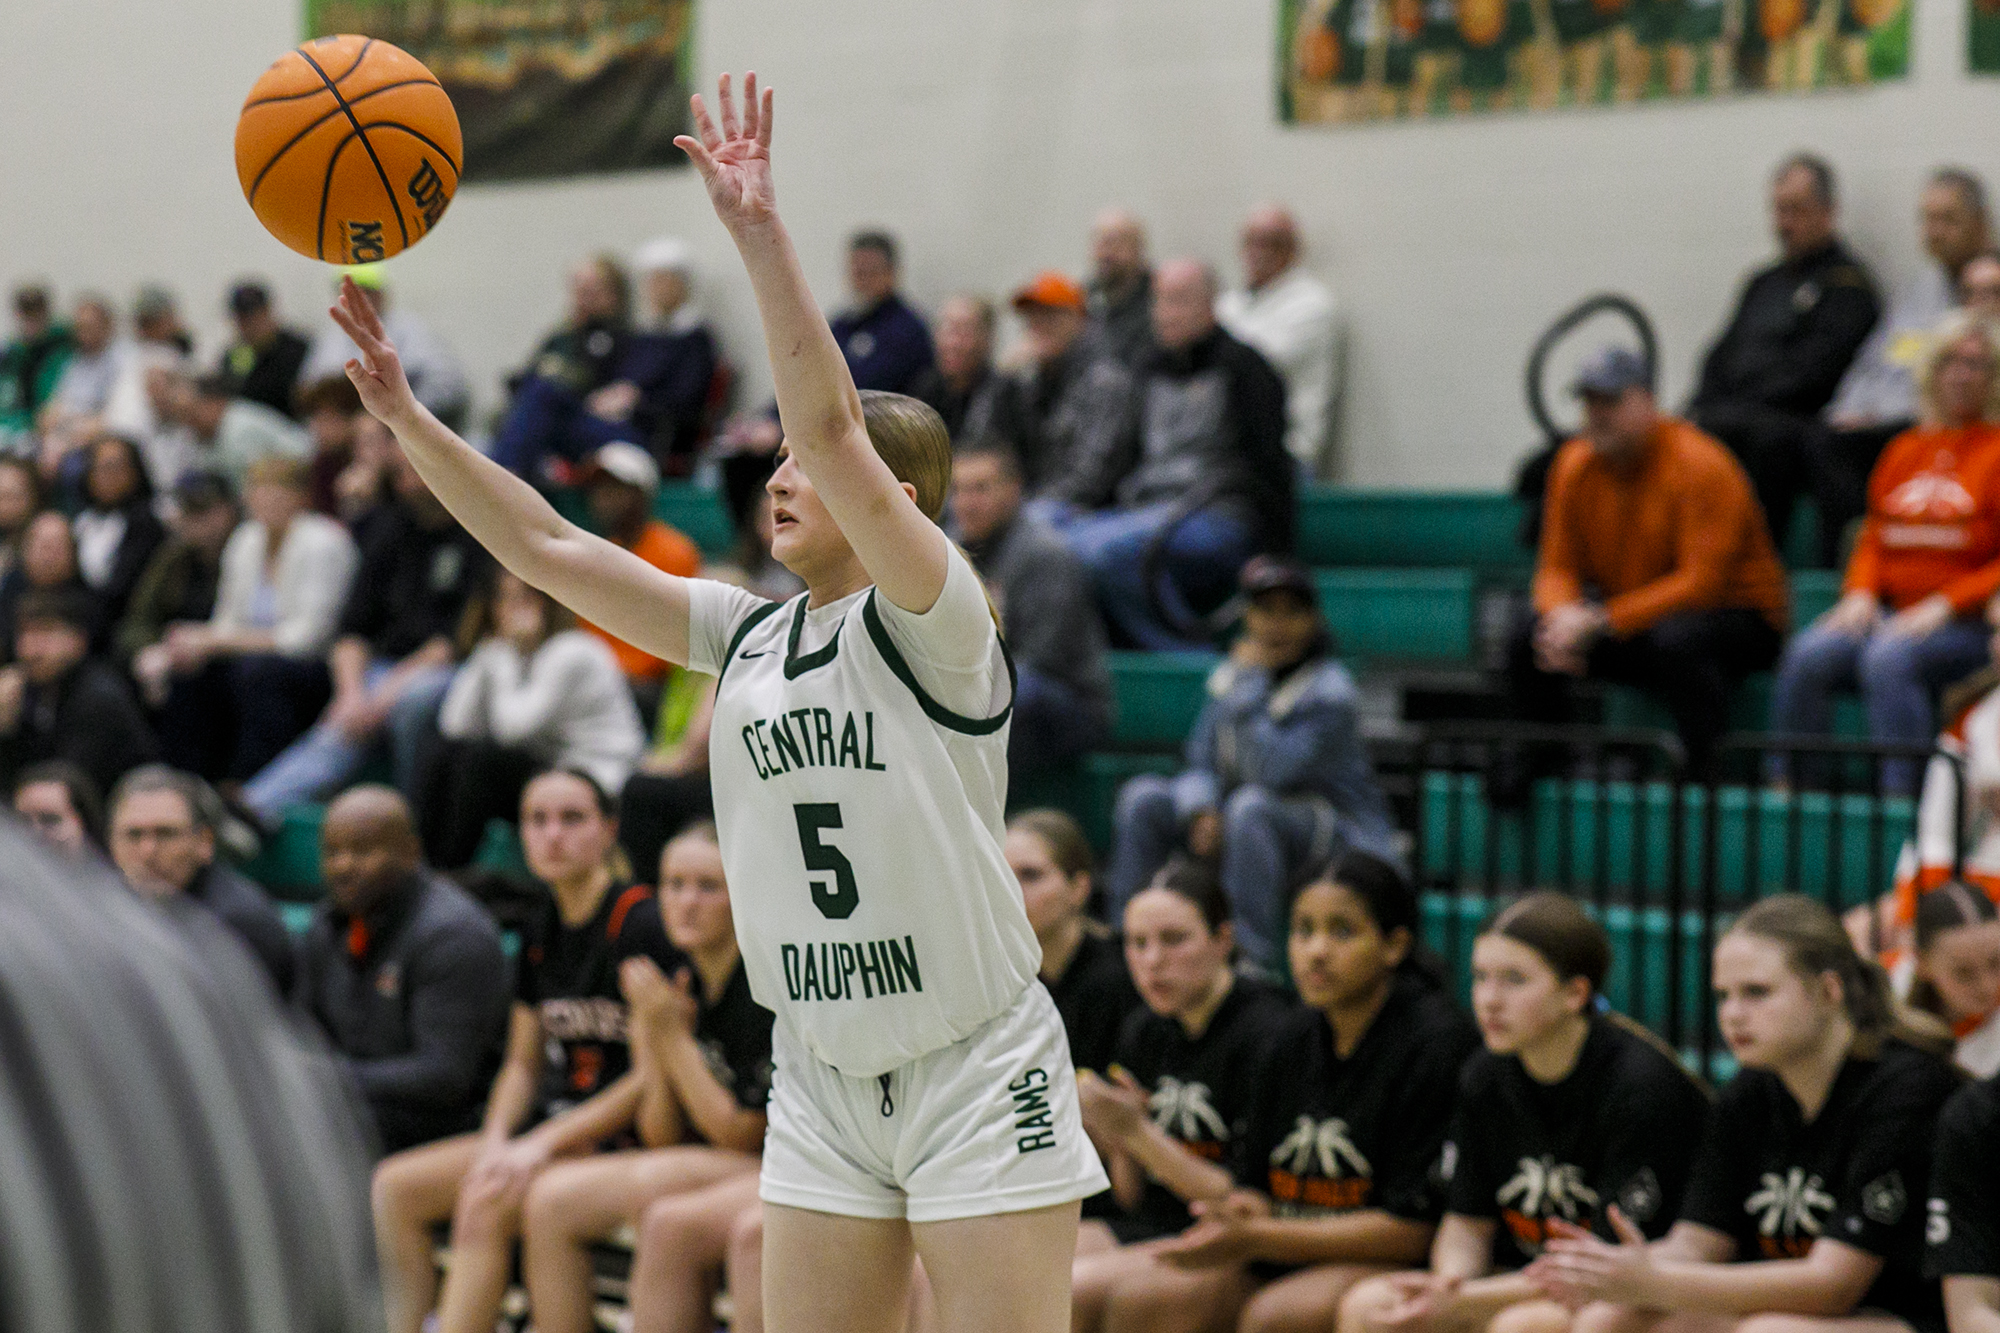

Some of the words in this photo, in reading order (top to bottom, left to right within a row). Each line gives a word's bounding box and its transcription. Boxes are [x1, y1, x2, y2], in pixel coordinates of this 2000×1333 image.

[742, 707, 886, 781] CENTRAL
[793, 802, 860, 919] 5
[781, 935, 924, 1002] DAUPHIN
[1009, 1068, 1056, 1154] RAMS
